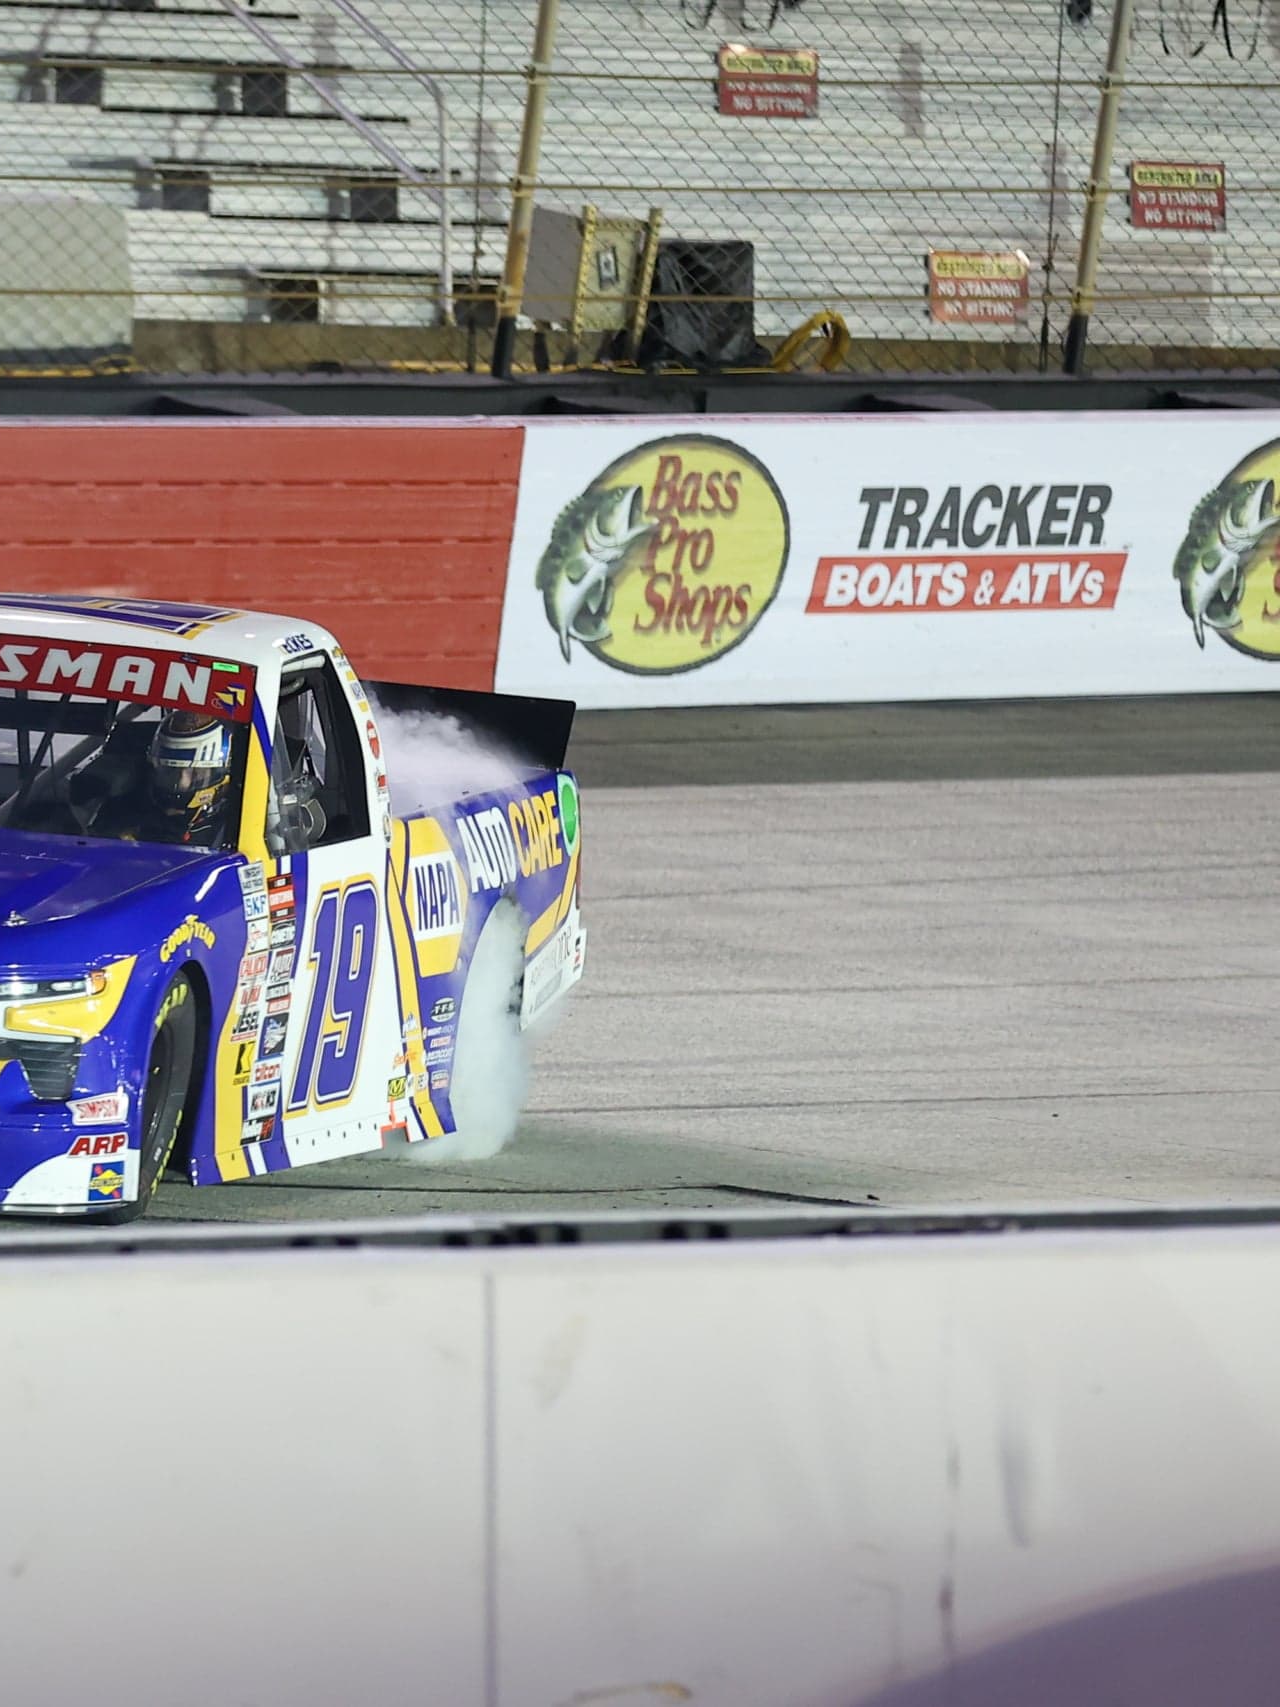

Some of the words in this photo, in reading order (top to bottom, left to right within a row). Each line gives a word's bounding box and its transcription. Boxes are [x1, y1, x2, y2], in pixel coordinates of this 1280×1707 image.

[1144, 207, 1162, 223] NO
[937, 281, 956, 297] NO
[647, 455, 743, 518] Bass
[857, 484, 1113, 550] TRACKER
[644, 515, 715, 573] Pro
[633, 571, 753, 646] Shops
[824, 565, 967, 608] BOATS
[974, 567, 995, 605] &
[1000, 562, 1106, 606] ATVs
[456, 806, 518, 893] AUTO
[507, 789, 563, 878] CARE
[414, 859, 461, 931] NAPA
[283, 872, 381, 1120] 19
[70, 1134, 126, 1156] ARP
